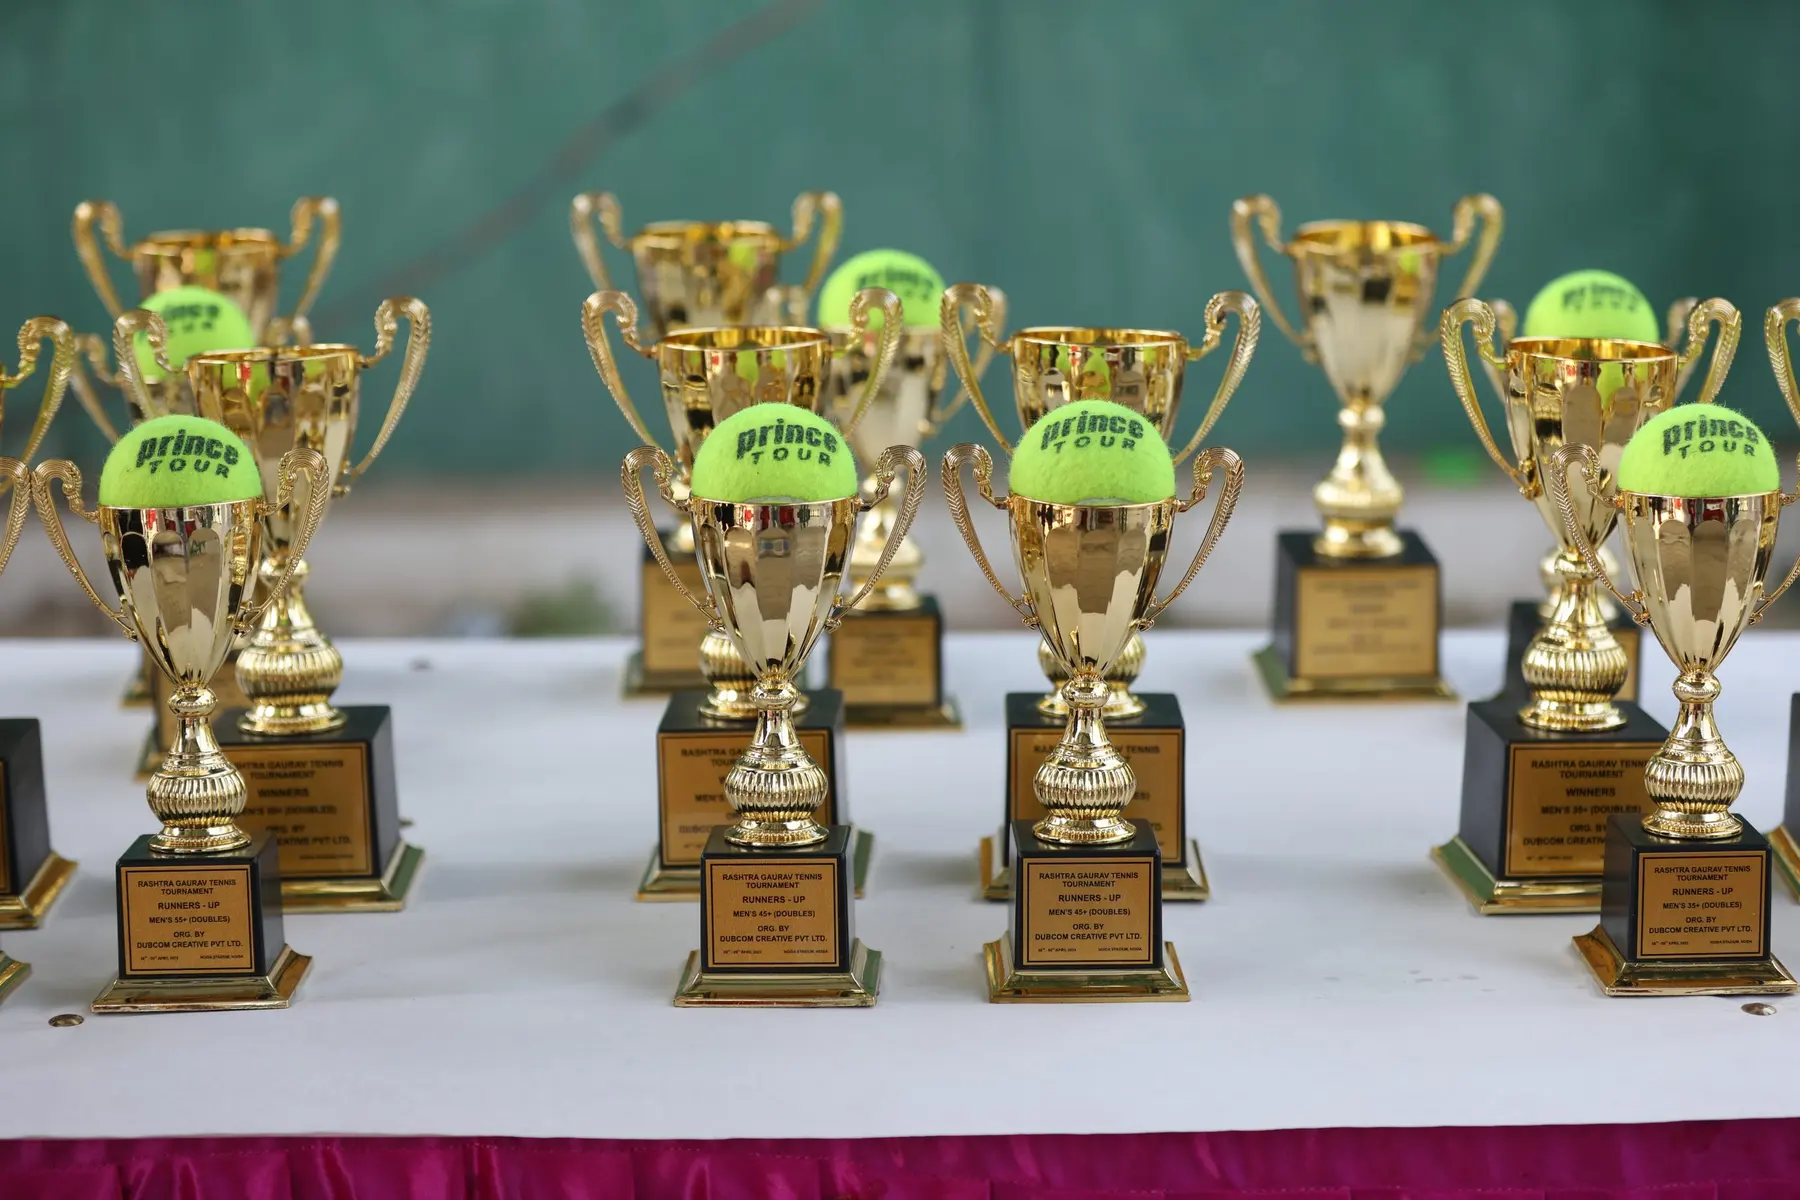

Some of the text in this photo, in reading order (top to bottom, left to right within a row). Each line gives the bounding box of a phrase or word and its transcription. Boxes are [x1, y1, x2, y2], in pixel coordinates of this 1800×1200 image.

[1040, 410, 1144, 450] prince
[1663, 414, 1758, 456] prince
[736, 418, 838, 460] prince
[1054, 436, 1136, 453] TOUR
[136, 428, 238, 468] prince
[1678, 440, 1756, 459] TOUR
[751, 447, 832, 466] TOUR
[149, 458, 230, 478] TOUR
[1532, 760, 1646, 769] RASHTRA GAURAV TENNI
[251, 771, 315, 779] TOURNAMENT
[1560, 770, 1624, 779] TOURNAMENT
[258, 788, 309, 797] WINNERS
[1566, 788, 1616, 797] WINNERS
[1541, 806, 1570, 814] MEN'S
[1591, 805, 1641, 815] (DOUBLES)
[1523, 836, 1605, 846] DUBCOM CREATIV
[189, 916, 230, 924] (DOUBLES)
